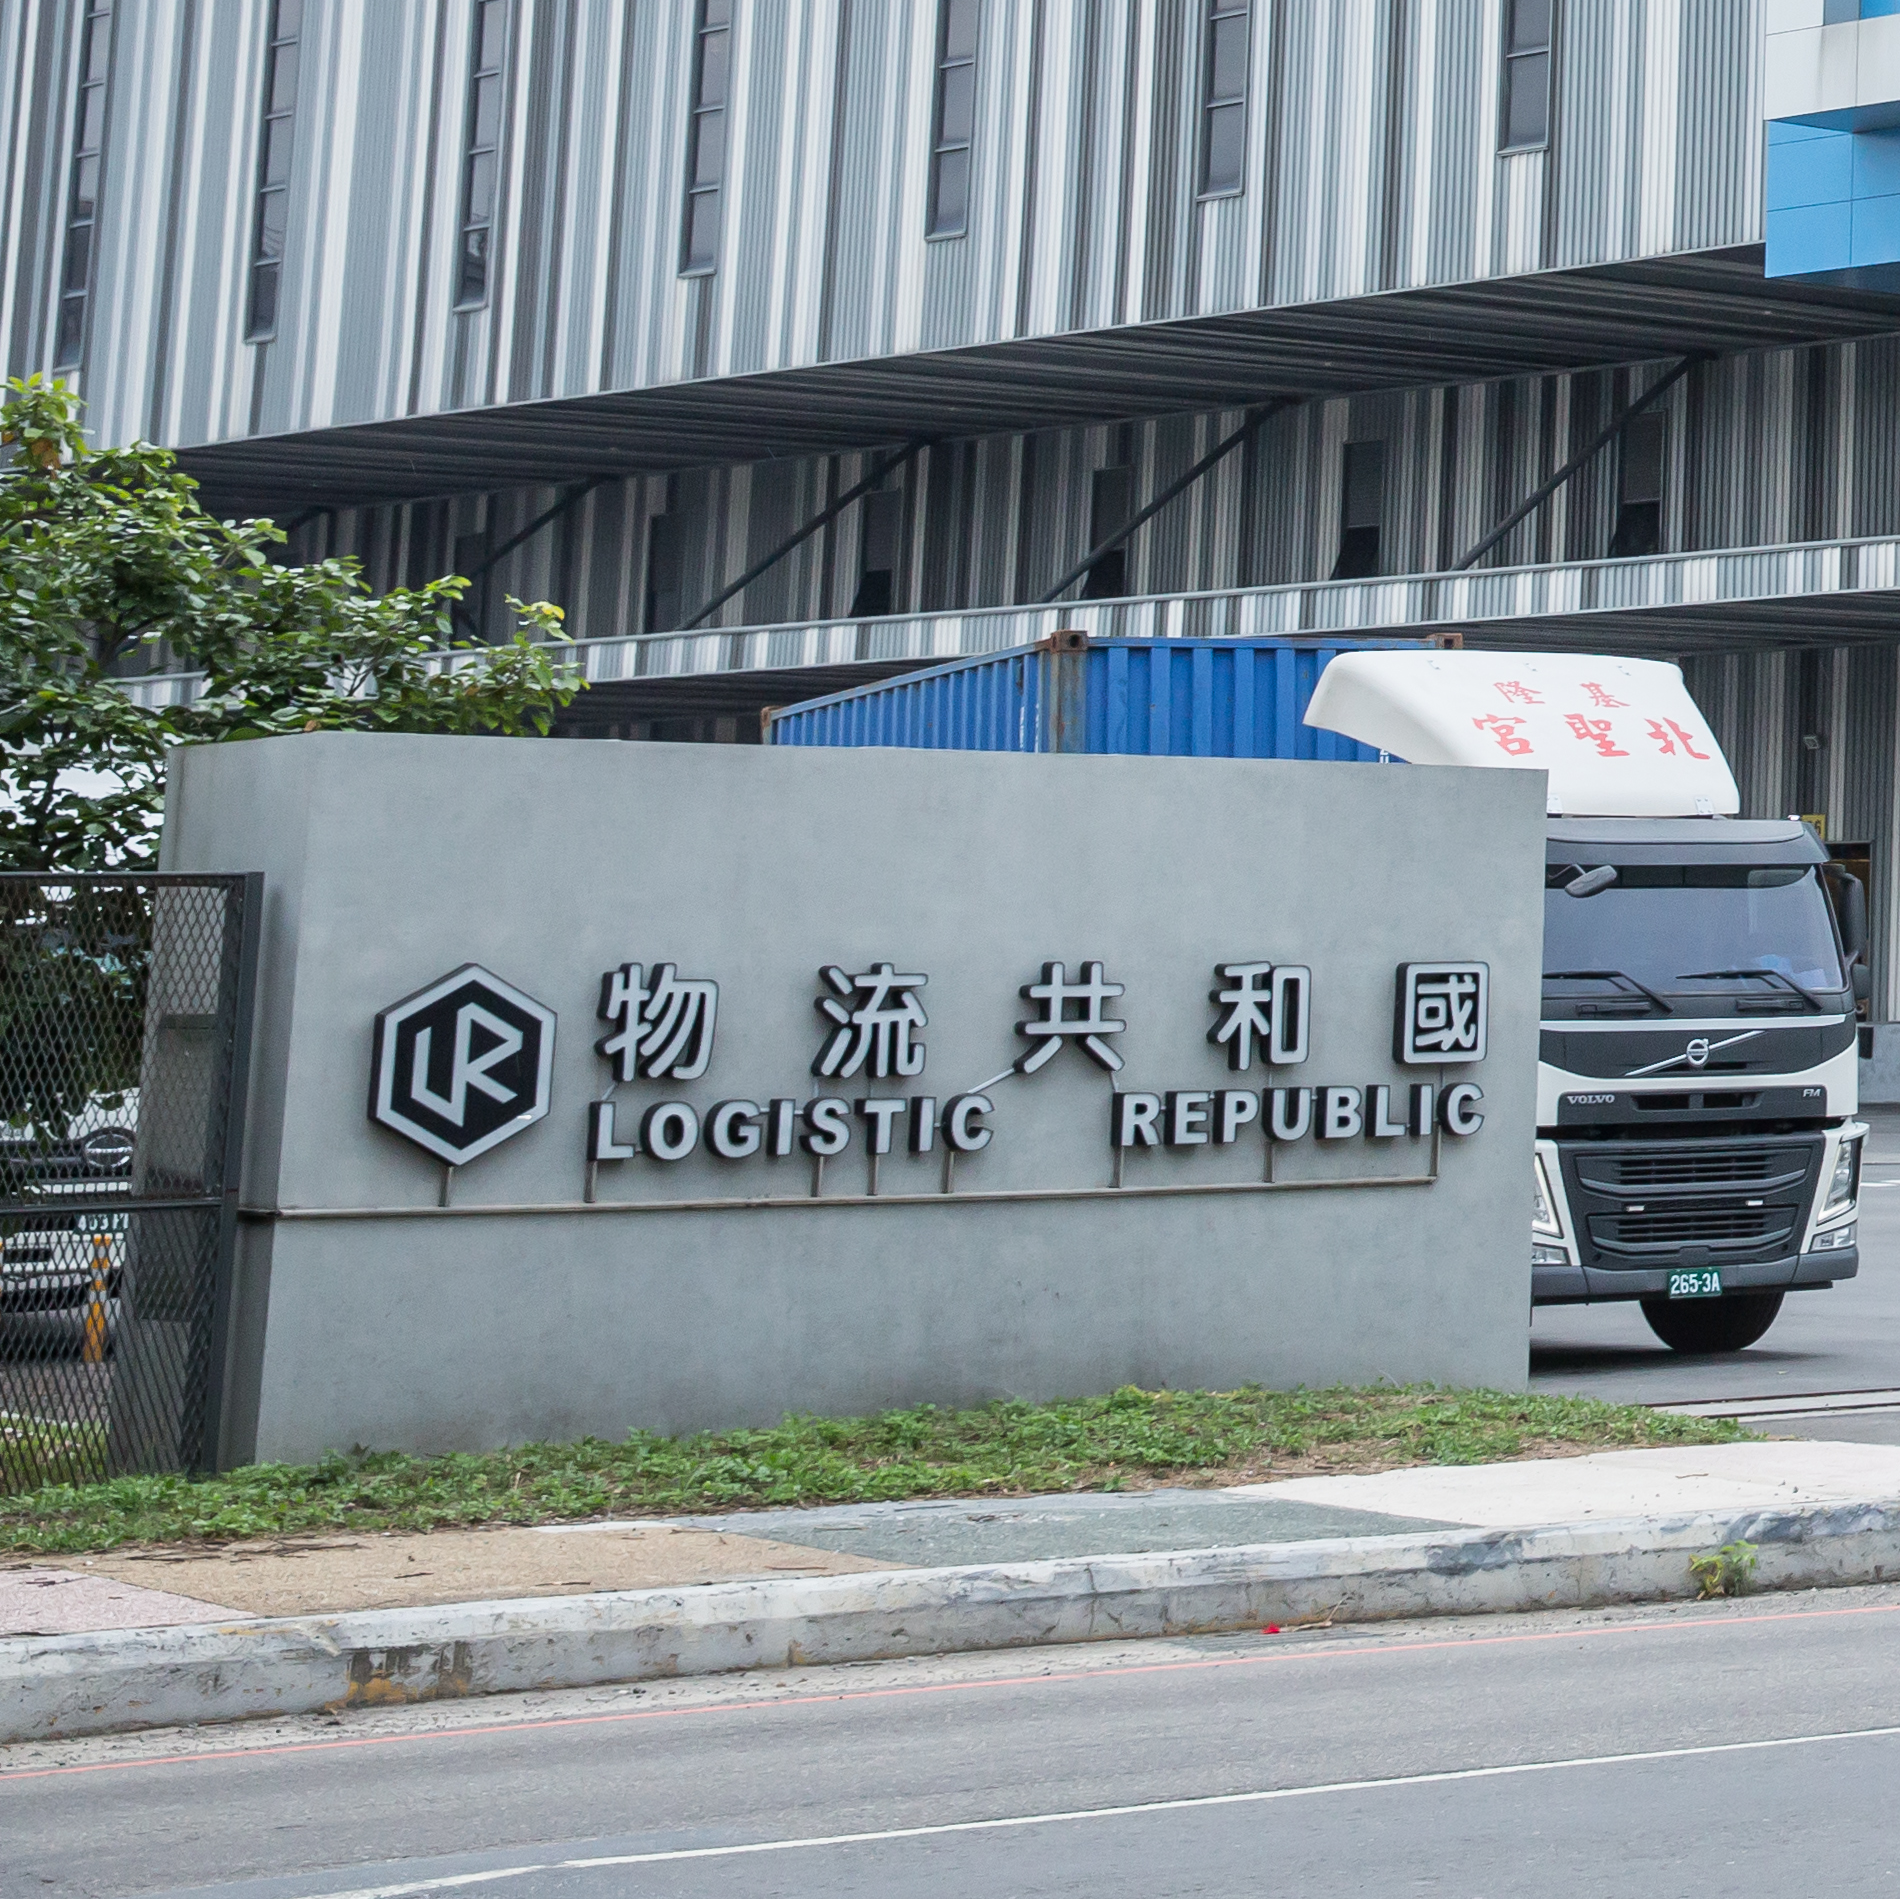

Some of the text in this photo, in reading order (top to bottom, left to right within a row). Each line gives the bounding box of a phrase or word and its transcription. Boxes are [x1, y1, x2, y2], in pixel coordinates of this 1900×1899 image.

[594, 960, 1490, 1078] 物流共和國
[1567, 1094, 1615, 1104] VOLVO
[1803, 1089, 1821, 1098] FM
[587, 1082, 1485, 1161] LOGISTIC REPUBLIC
[1671, 1272, 1720, 1294] 265-3A
